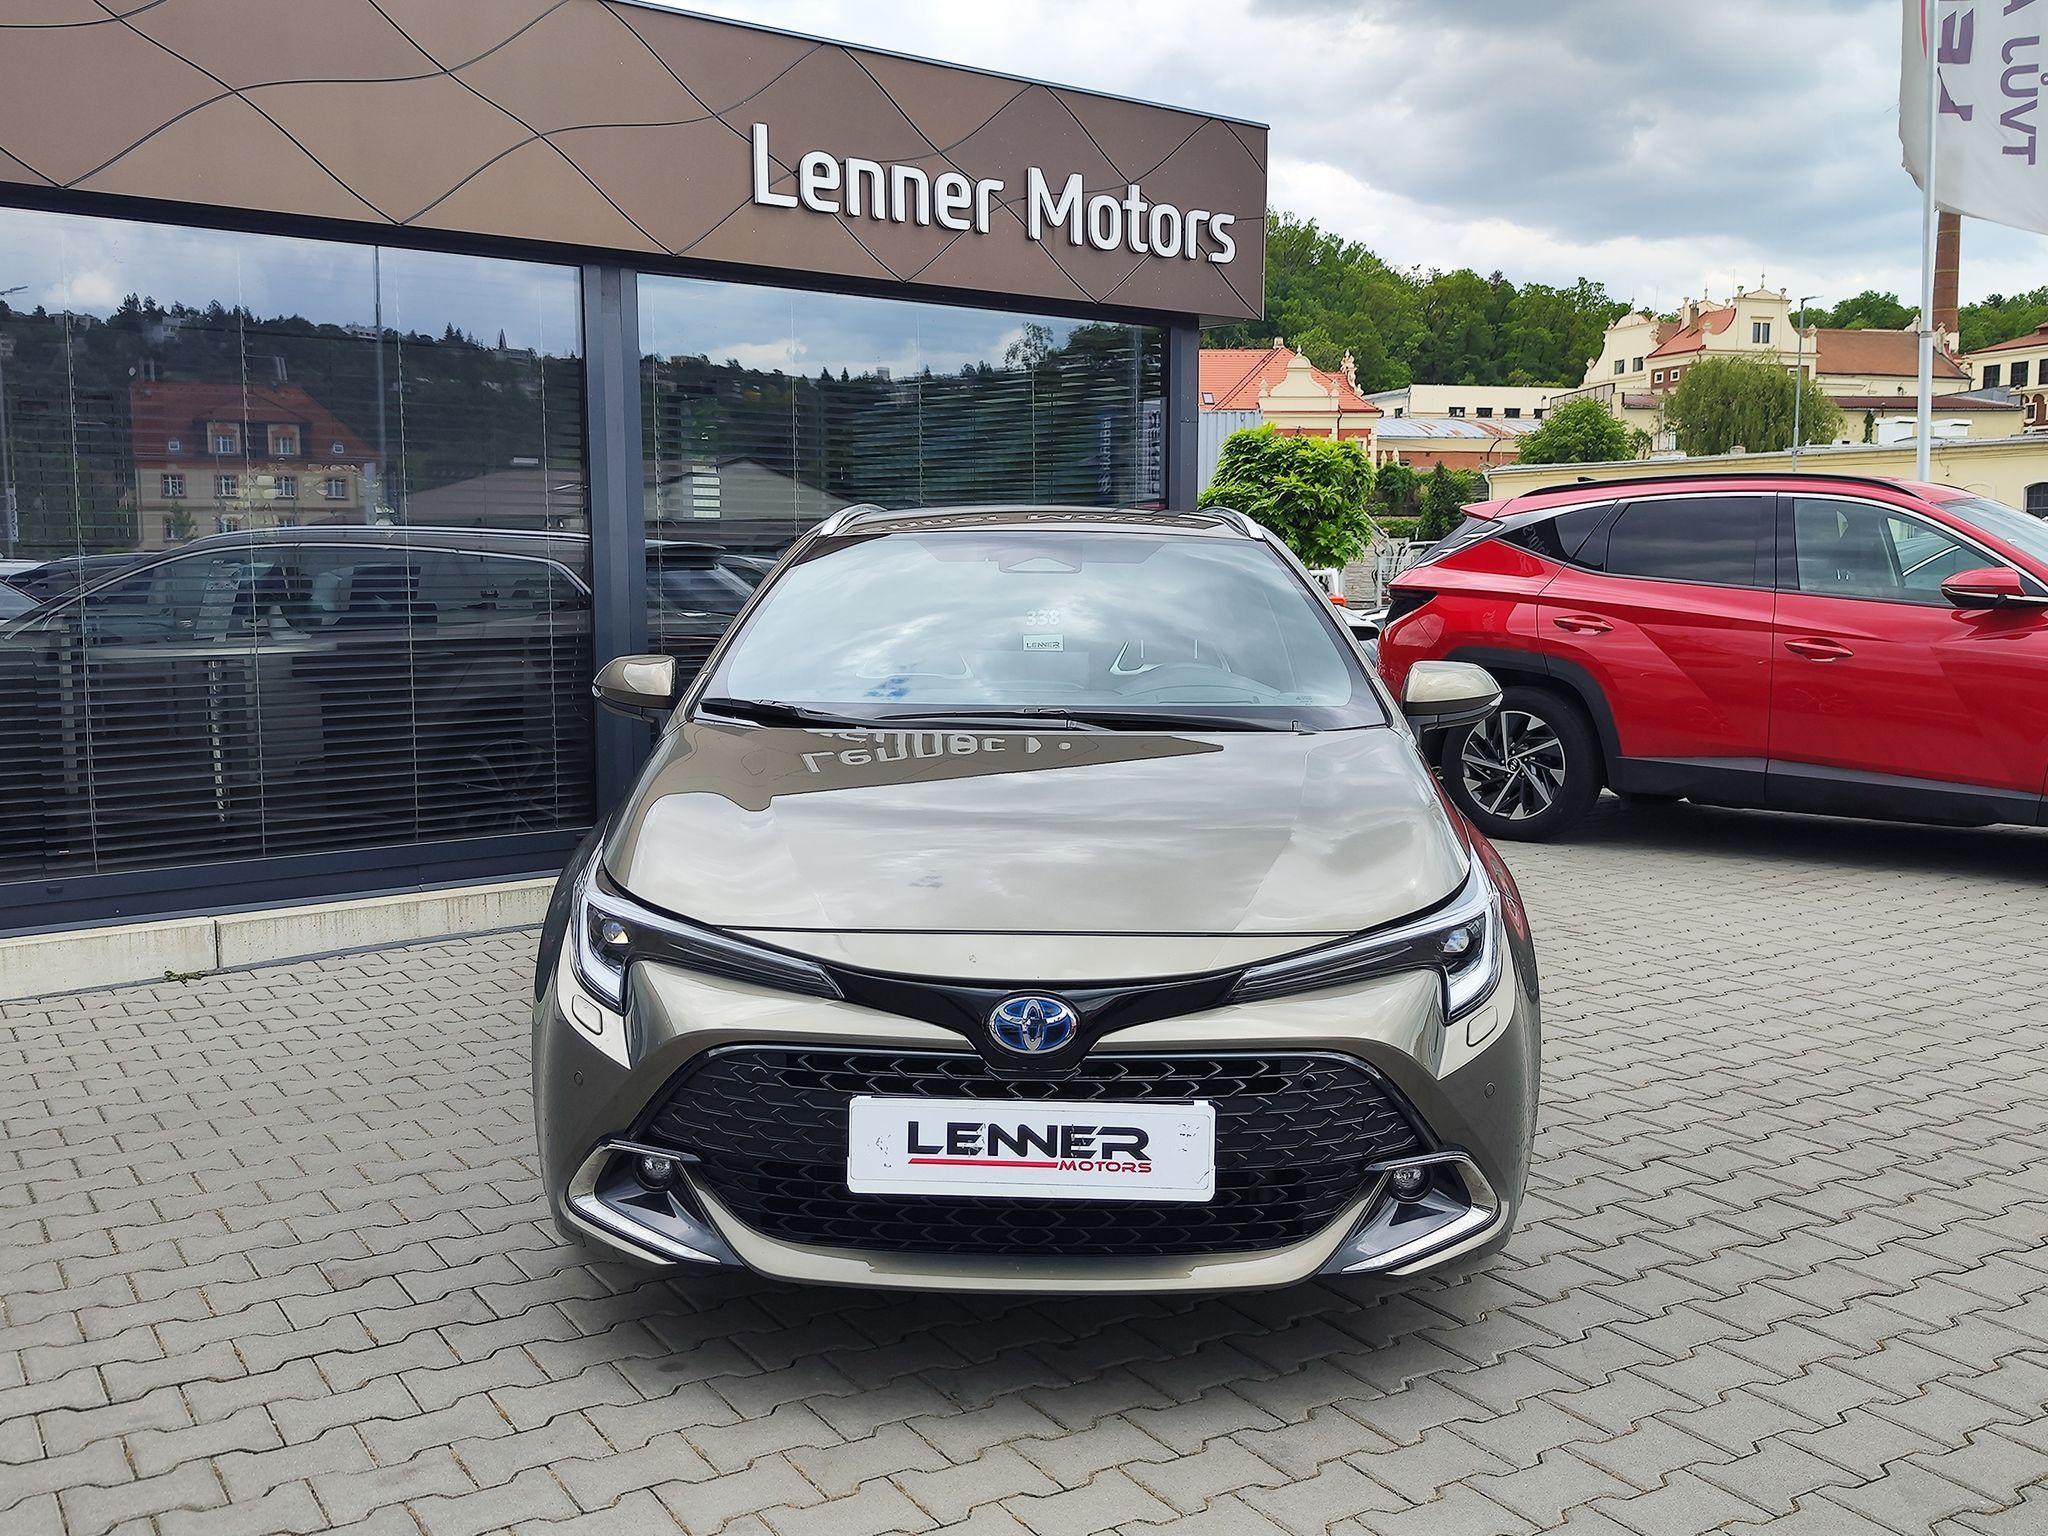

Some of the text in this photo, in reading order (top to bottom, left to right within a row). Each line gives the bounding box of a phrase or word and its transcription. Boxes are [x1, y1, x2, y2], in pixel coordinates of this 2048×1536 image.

[752, 122, 1237, 263] Lenner Motors
[1026, 641, 1060, 649] LENNER
[907, 1121, 1152, 1160] LENNER
[1058, 1160, 1152, 1173] MOTORS
